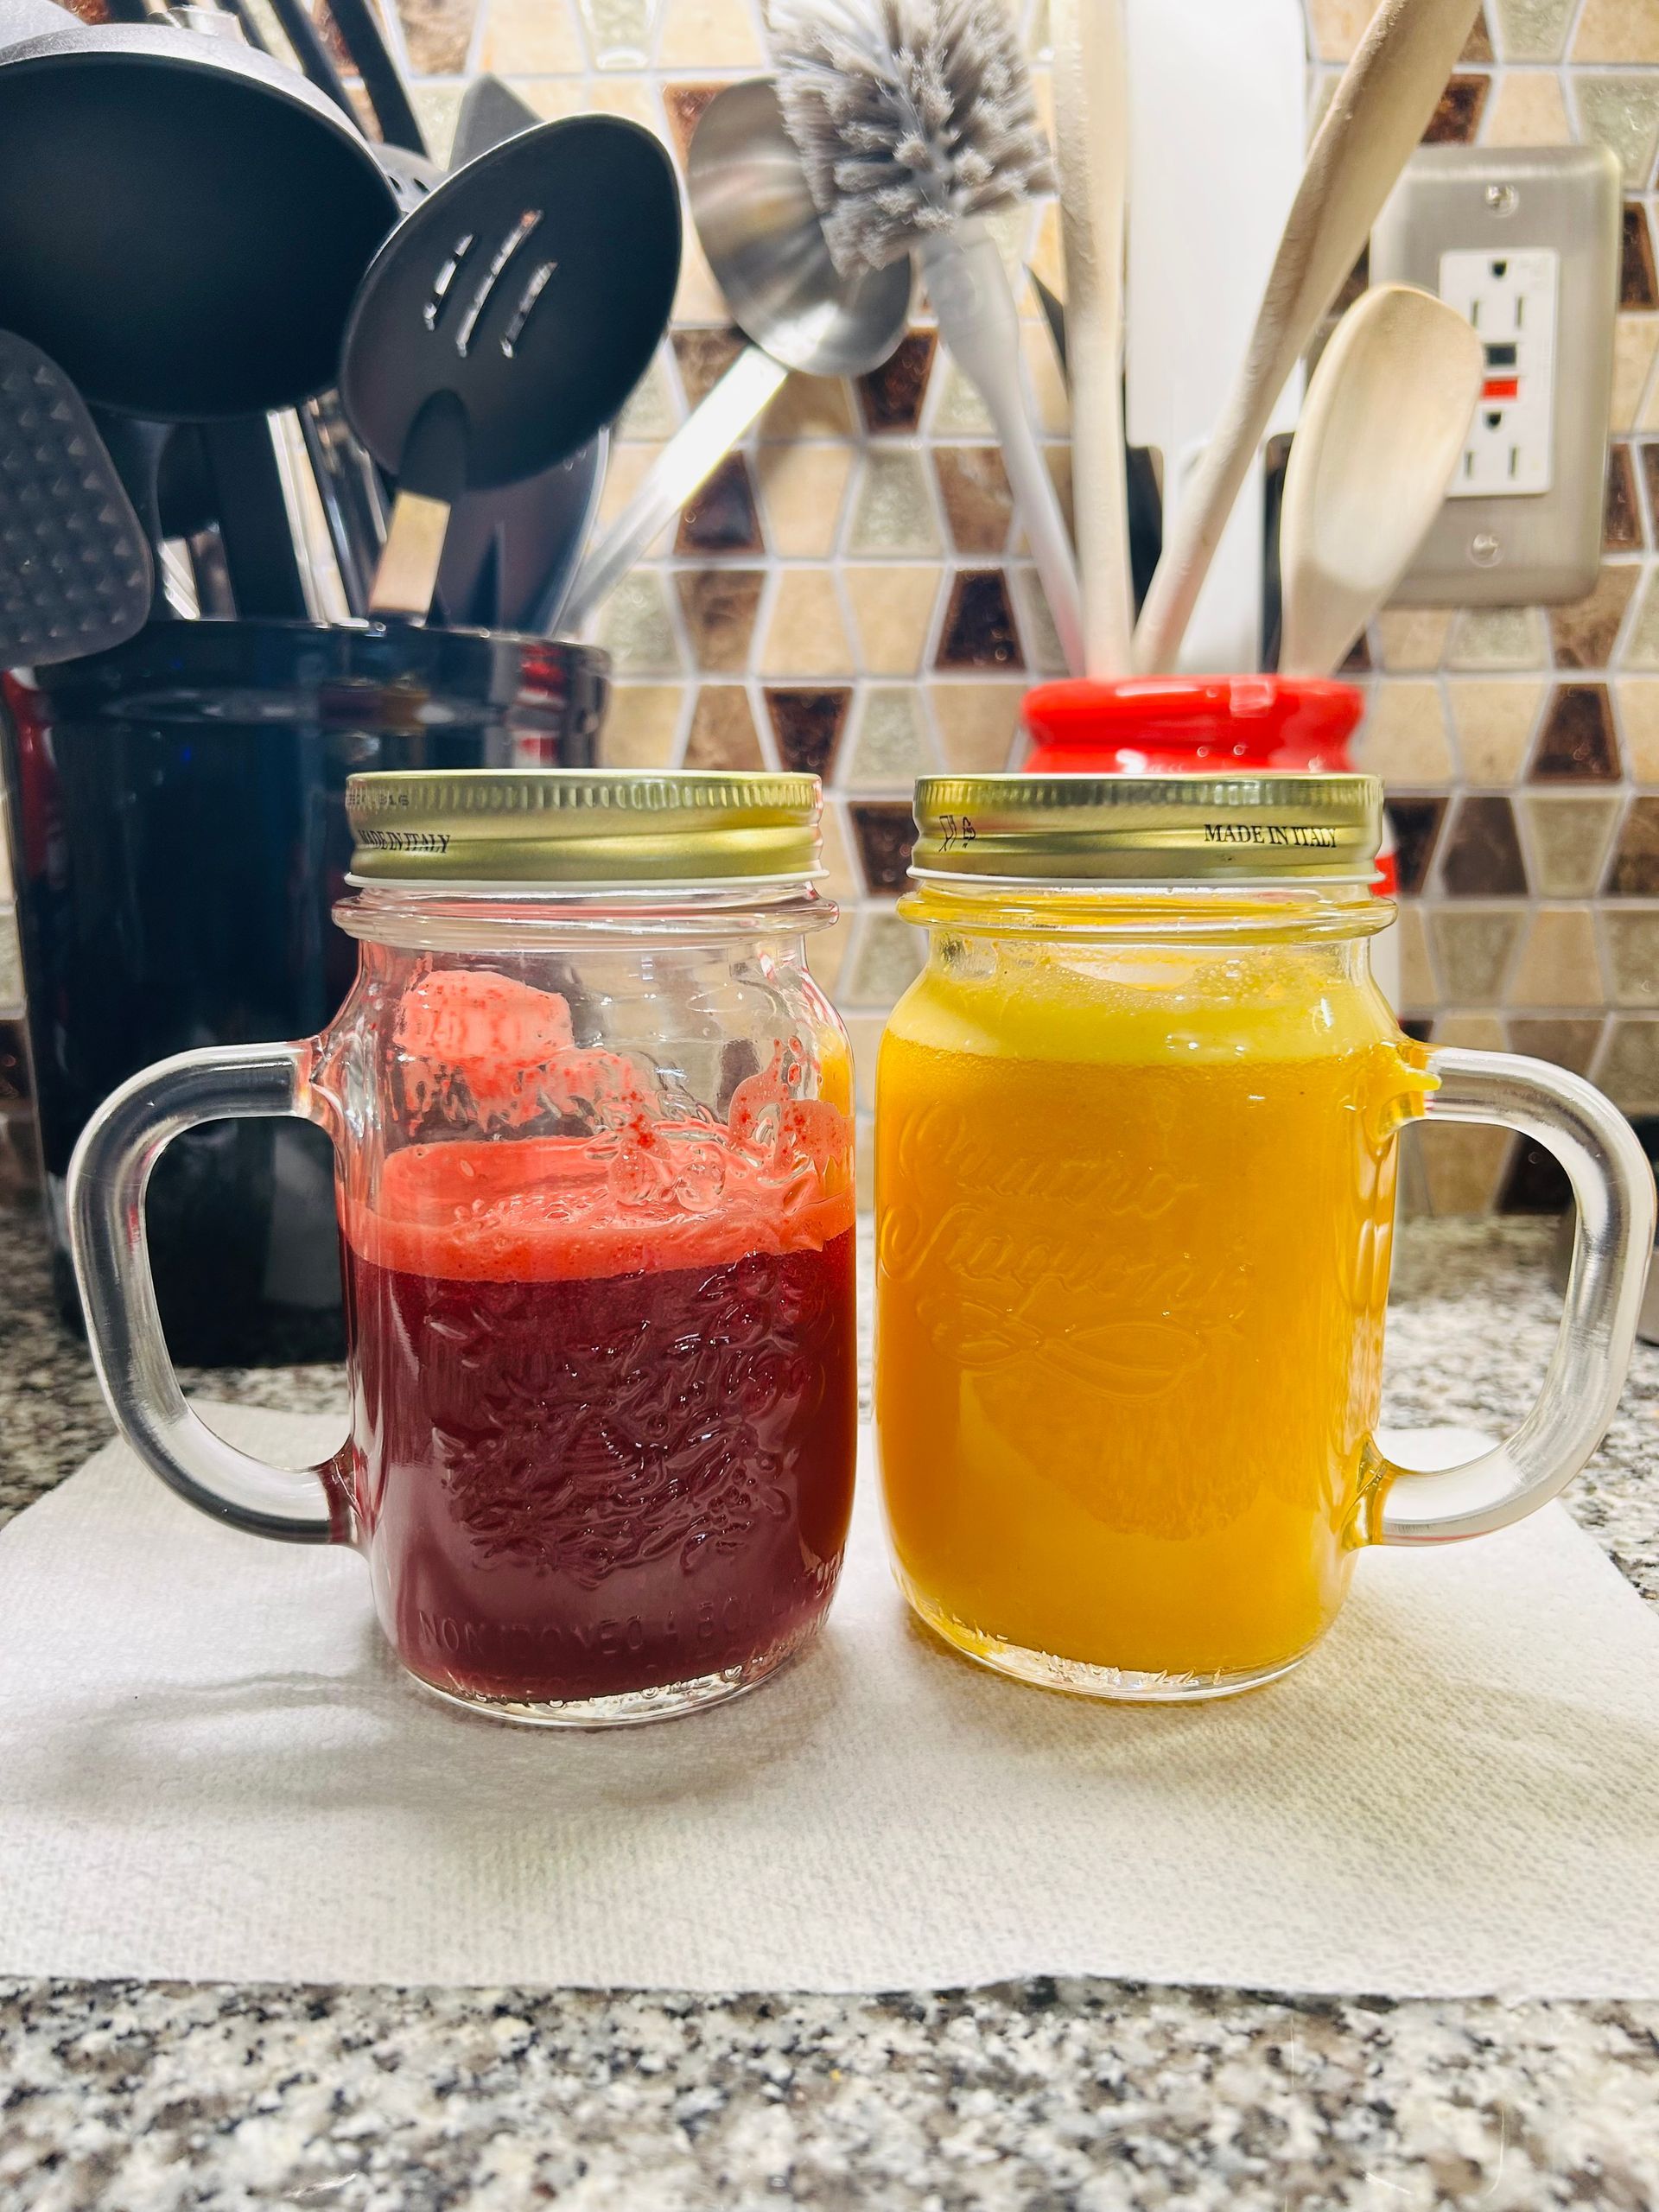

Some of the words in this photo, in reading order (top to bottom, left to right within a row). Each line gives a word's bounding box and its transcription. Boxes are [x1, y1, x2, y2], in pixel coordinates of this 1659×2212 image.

[358, 829, 389, 850] MADE
[385, 830, 404, 851] IN
[403, 832, 451, 854] ITALY
[1204, 823, 1265, 844] MADE
[1265, 824, 1289, 846] IN
[1290, 825, 1337, 848] ITALY
